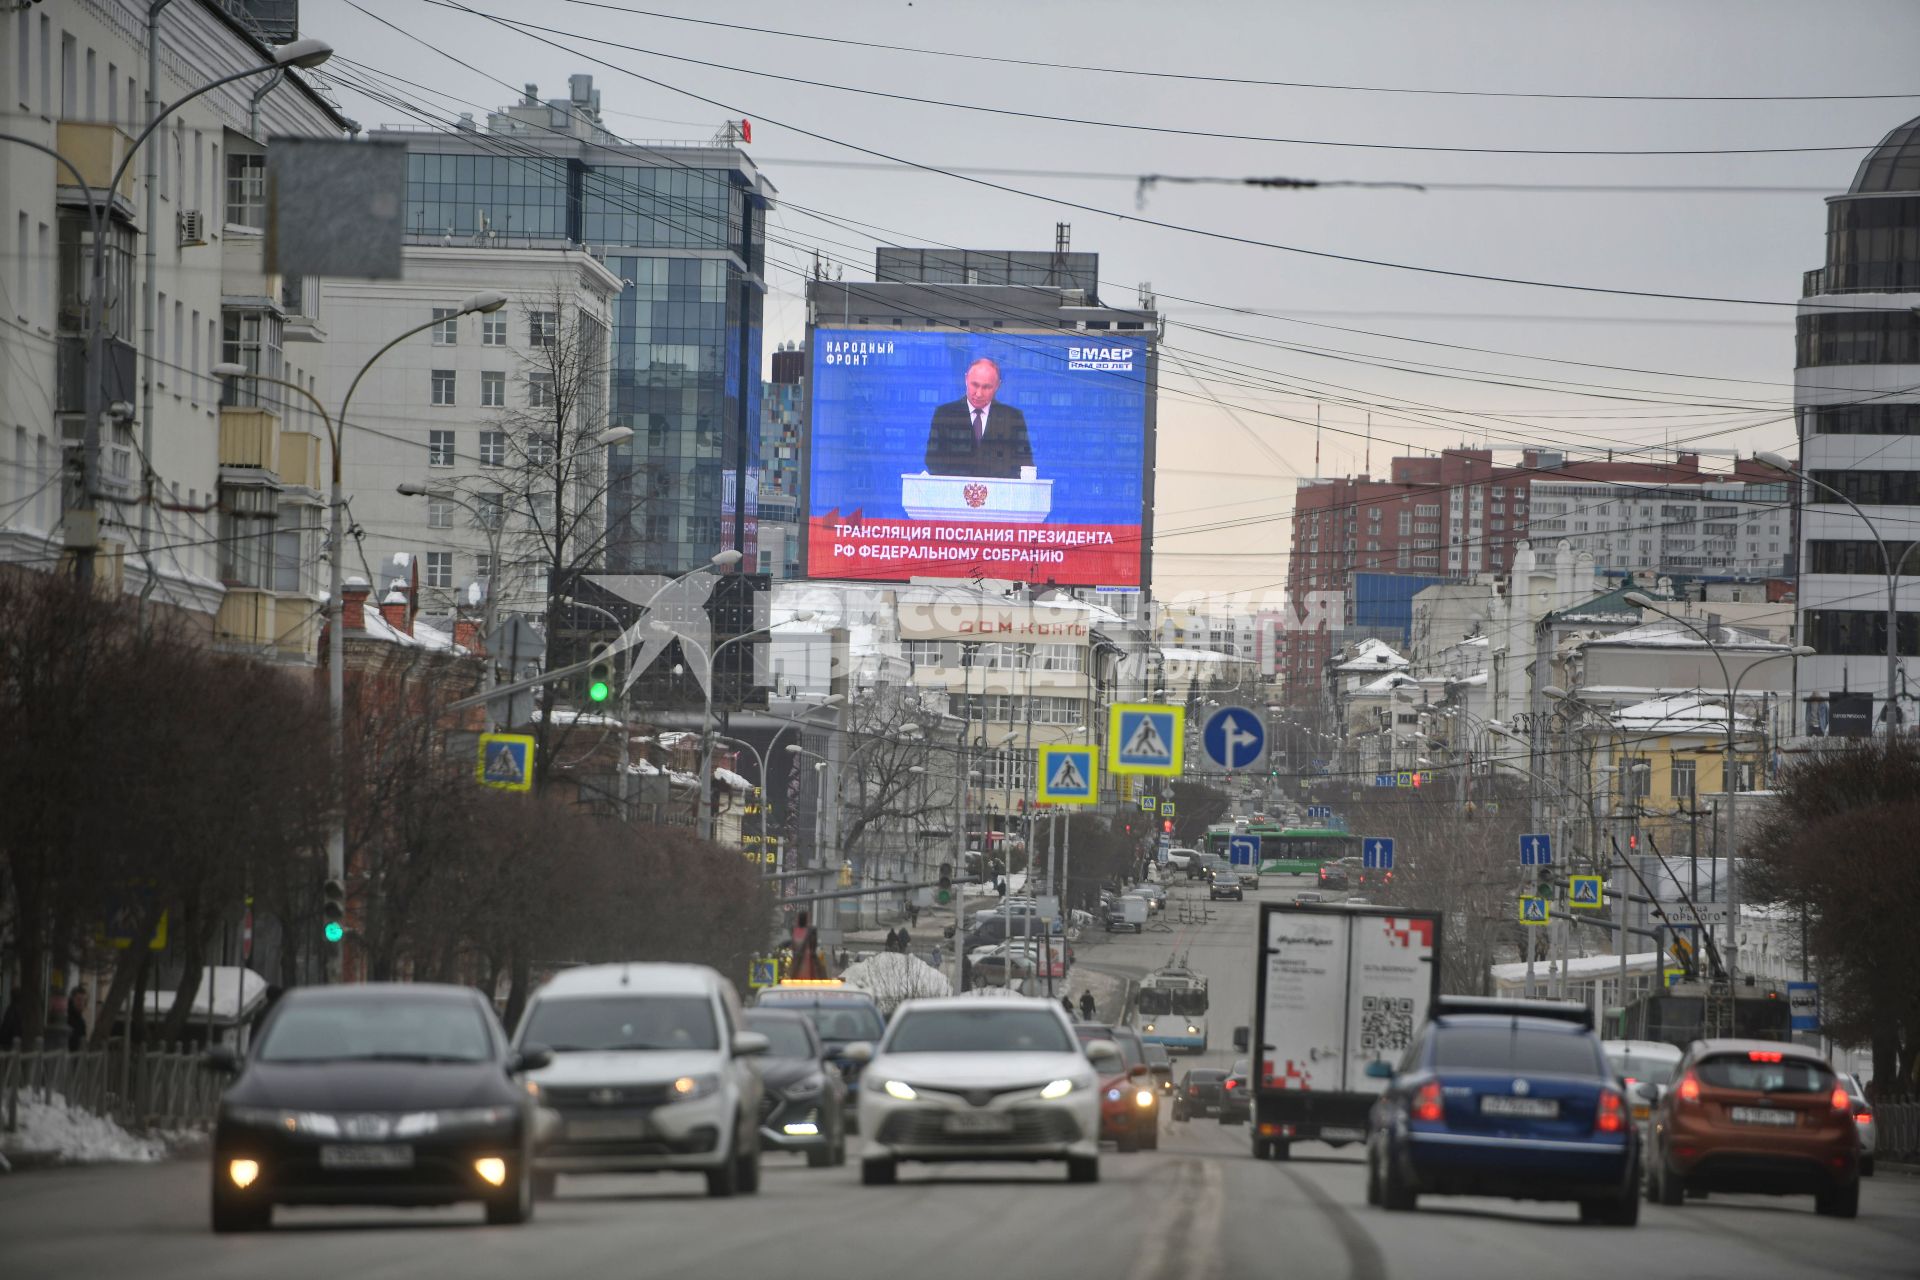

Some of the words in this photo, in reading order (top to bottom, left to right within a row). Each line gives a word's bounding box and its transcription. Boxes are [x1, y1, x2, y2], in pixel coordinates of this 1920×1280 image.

[826, 341, 894, 354] НАРОДНЫЙ
[1082, 347, 1133, 361] МАЕР
[826, 353, 868, 366] ФРОНТ
[834, 524, 931, 541] ТРАНСЛЯЦИЯ
[935, 527, 1014, 542] ПОСЛАНИЯ
[1018, 529, 1114, 545] ПРЕЗИДЕНТА
[834, 544, 855, 557] РФ
[858, 545, 979, 560] ФЕДЕРАЛЬНОМУ
[982, 548, 1064, 563] СОБРАНИЮ
[959, 620, 1012, 633] ДОМ
